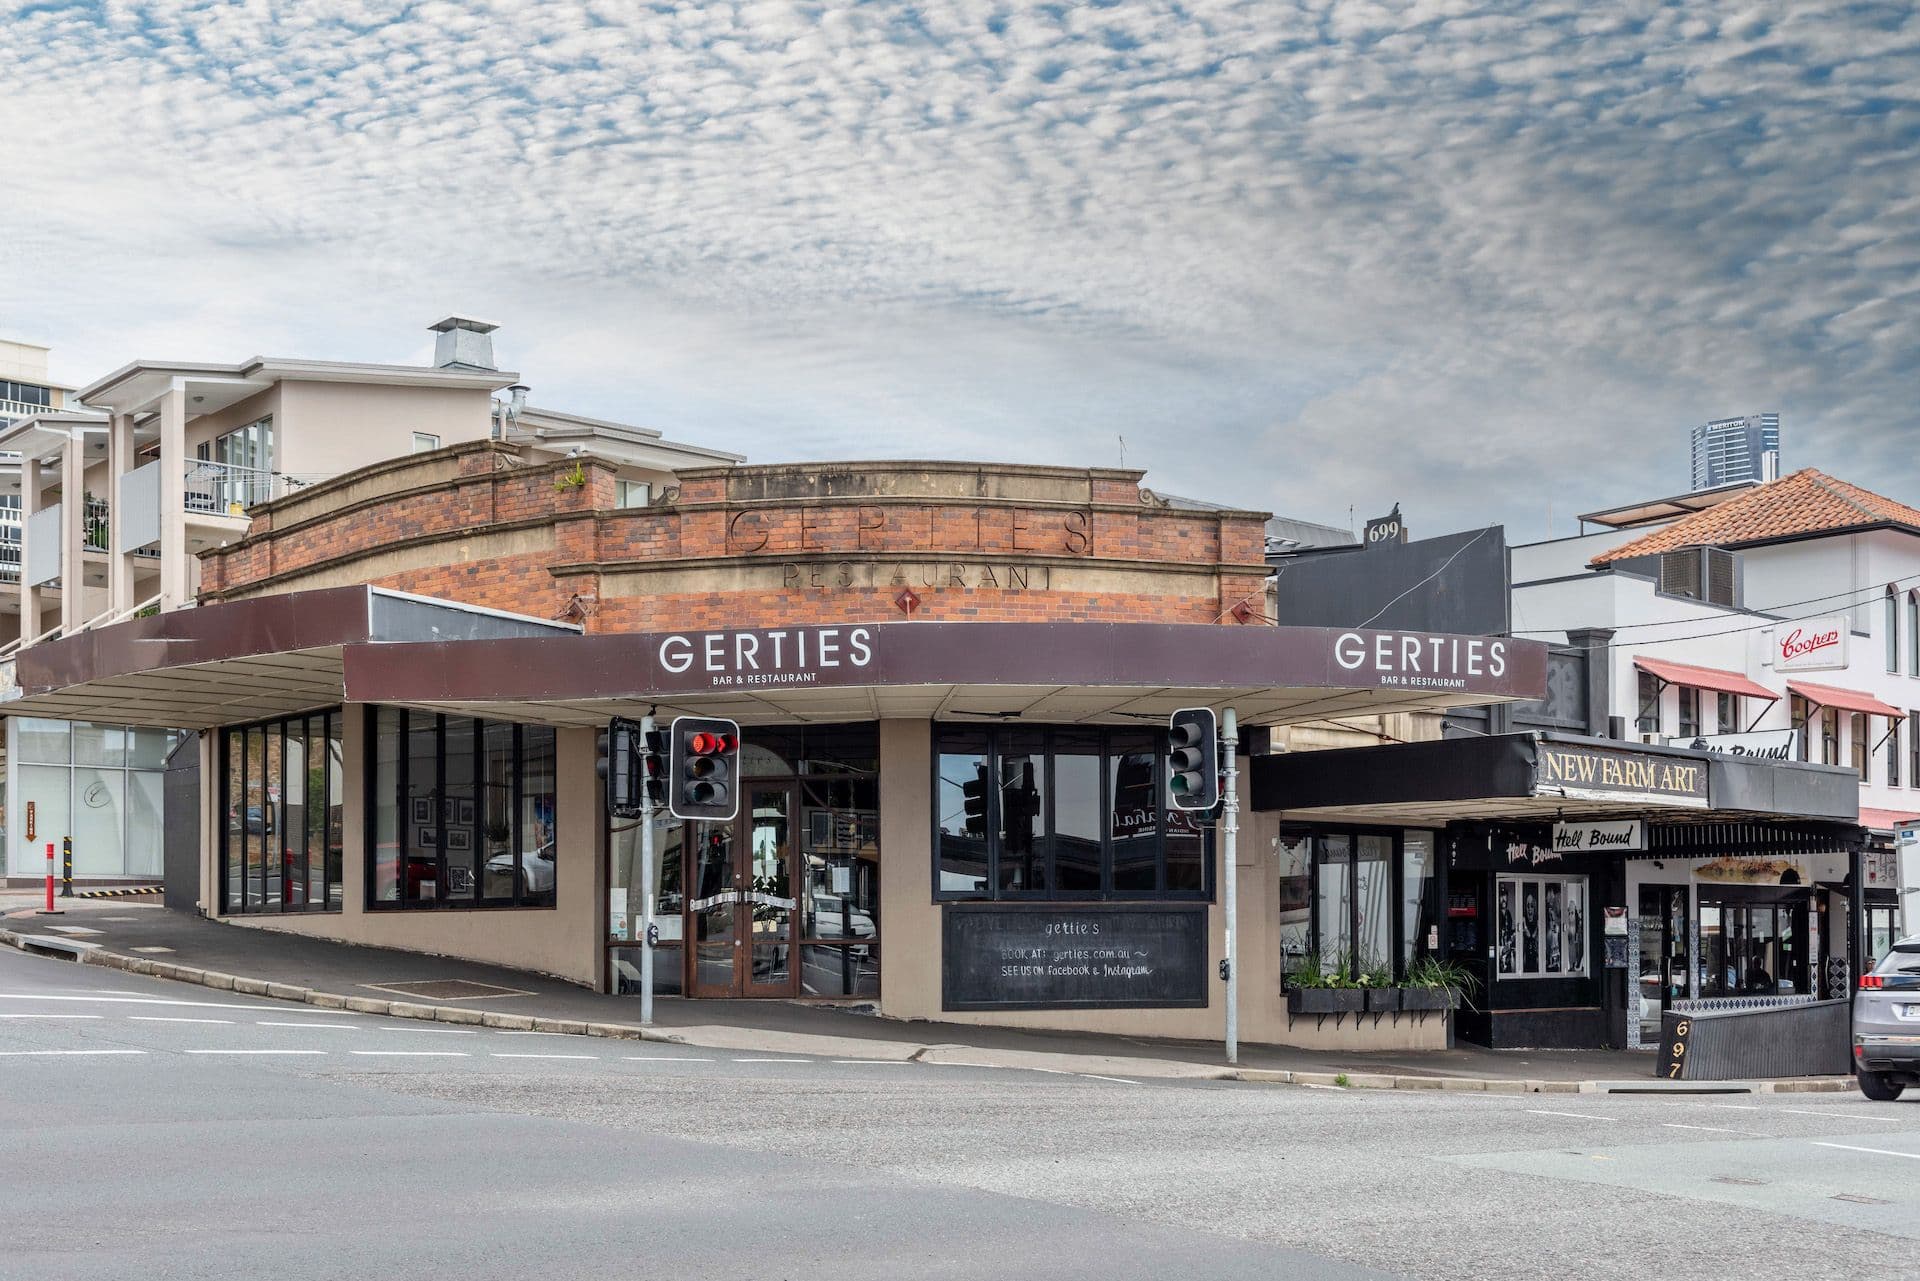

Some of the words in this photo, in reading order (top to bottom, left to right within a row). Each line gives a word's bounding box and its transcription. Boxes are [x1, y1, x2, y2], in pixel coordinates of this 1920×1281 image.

[1369, 521, 1399, 542] 699
[659, 628, 872, 673] GERTIES
[1334, 632, 1505, 677] GERTIES
[1780, 628, 1838, 658] Coopers
[712, 676, 733, 686] BAR
[736, 675, 744, 684] &
[747, 672, 817, 684] RESTAURANT
[1381, 675, 1398, 684] BAR
[1401, 676, 1408, 685] &
[1410, 677, 1466, 688] RESTAURANT
[1545, 752, 1599, 783] NEW
[1600, 757, 1656, 789] FARM
[1660, 765, 1698, 792] ART
[1555, 828, 1583, 849] Hell
[1588, 824, 1634, 848] Bound
[1506, 843, 1528, 864] Hell
[1001, 948, 1028, 960] BOOK
[1031, 948, 1046, 959] AT:
[1001, 965, 1019, 976] SEE
[1020, 965, 1032, 976] US
[1033, 965, 1044, 975] ON
[1092, 966, 1100, 976] &
[1669, 1020, 1689, 1078] 697
